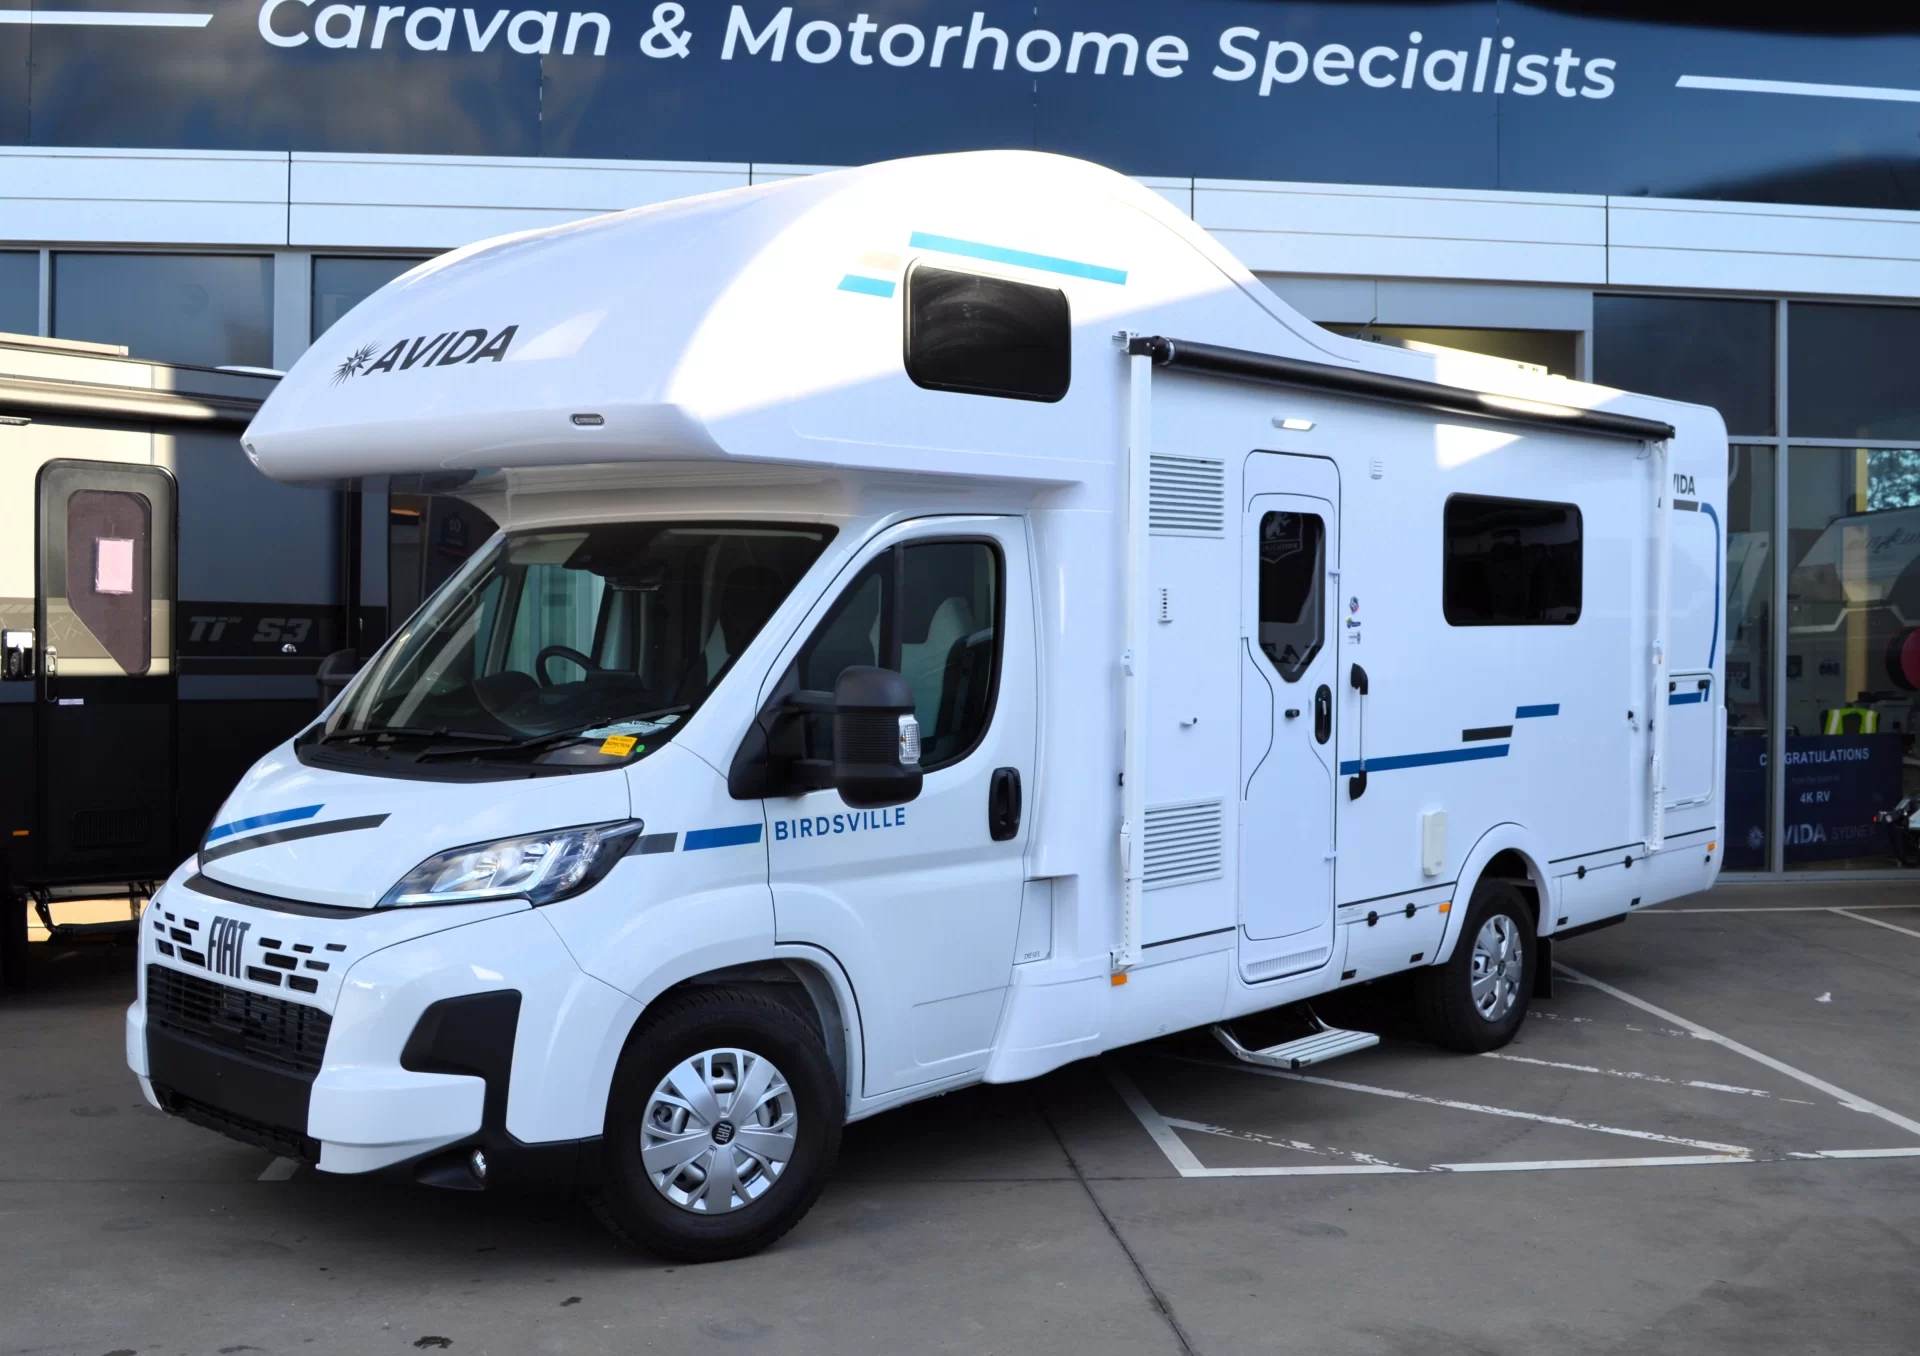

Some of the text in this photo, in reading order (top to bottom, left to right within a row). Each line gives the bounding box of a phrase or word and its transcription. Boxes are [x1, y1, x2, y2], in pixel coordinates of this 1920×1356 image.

[257, 0, 1617, 100] Caravan & Motorhome Specialists
[361, 324, 520, 377] AVIDA
[251, 616, 314, 643] S3
[1759, 747, 1870, 766] CGRATULATIONS
[1800, 790, 1831, 804] 4K RV
[774, 806, 907, 842] BIRDSVILLE
[1783, 823, 1827, 845] VIDA
[207, 915, 252, 980] FIAT
[715, 1123, 733, 1143] FIAT
